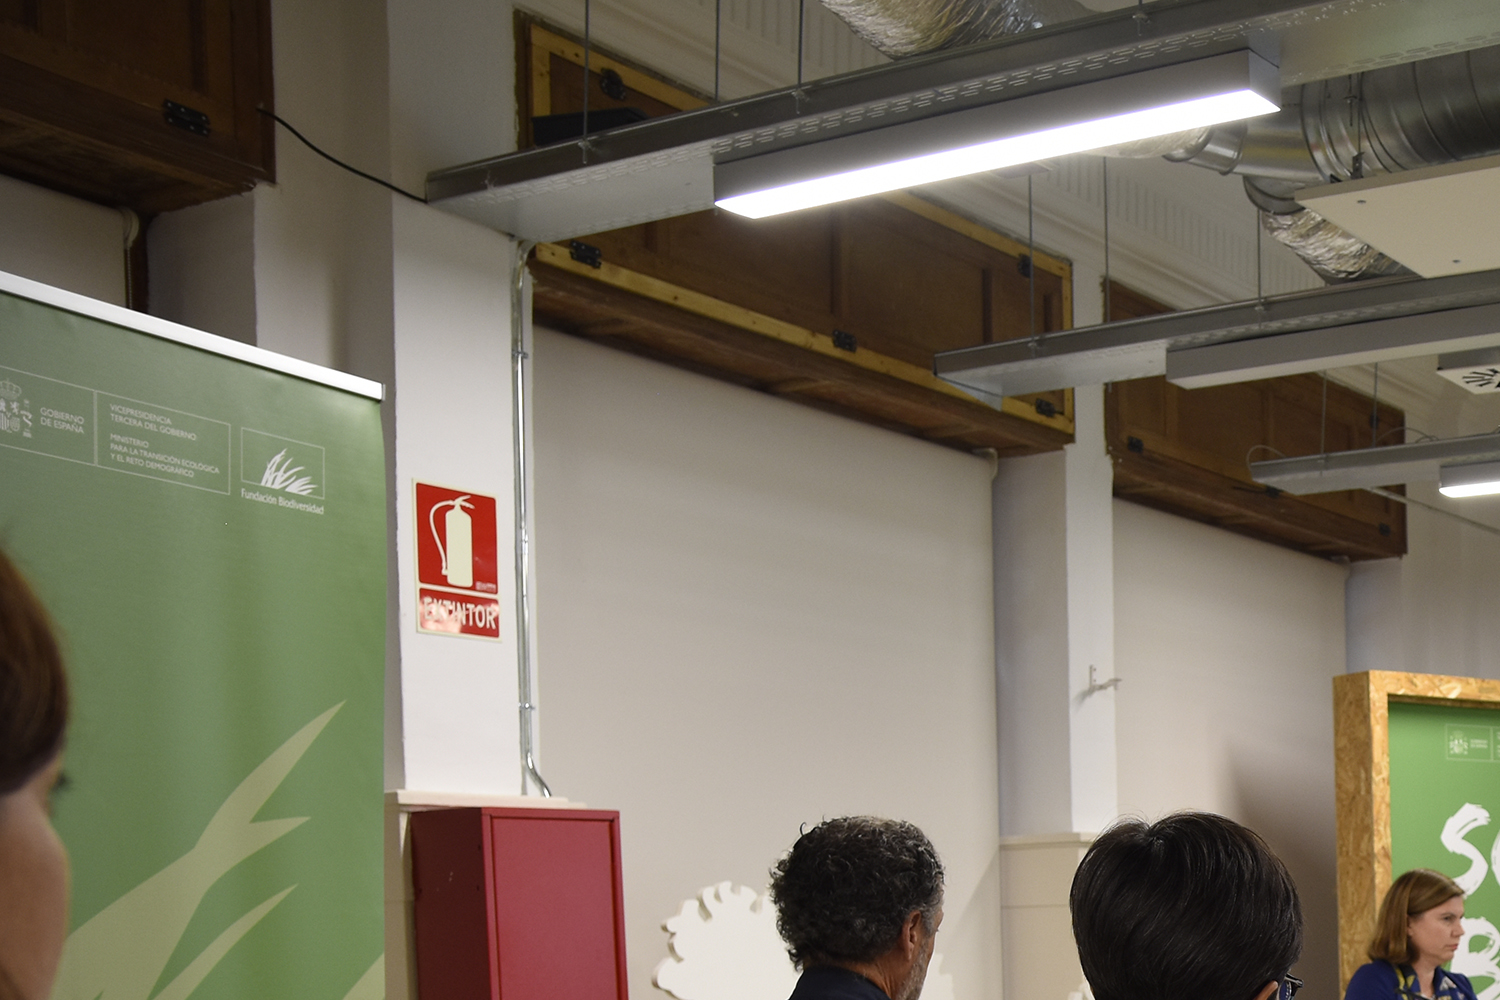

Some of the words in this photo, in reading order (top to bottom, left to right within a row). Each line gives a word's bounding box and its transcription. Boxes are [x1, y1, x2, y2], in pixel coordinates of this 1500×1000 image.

[40, 407, 85, 425] GOBIERNO
[40, 417, 52, 427] DE
[54, 419, 84, 434] ESPAÑA
[110, 404, 172, 425] VICEPRESIDENCIA
[110, 414, 143, 428] TERCERA
[144, 421, 158, 431] DEL
[160, 424, 196, 441] GOBIERNO
[110, 434, 149, 448] MINISTERIO
[110, 443, 128, 453] PARA
[129, 446, 139, 456] LA
[139, 449, 181, 465] TRANSICIÓN
[182, 458, 220, 474] ECOLÓGICA
[110, 453, 115, 461] Y
[116, 454, 125, 463] EL
[126, 456, 144, 467] RETO
[145, 461, 194, 478] DEMOGRÁFICO
[241, 488, 277, 505] Fundación
[278, 496, 324, 515] Biodiversidad
[423, 596, 496, 629] EXTINTOR
